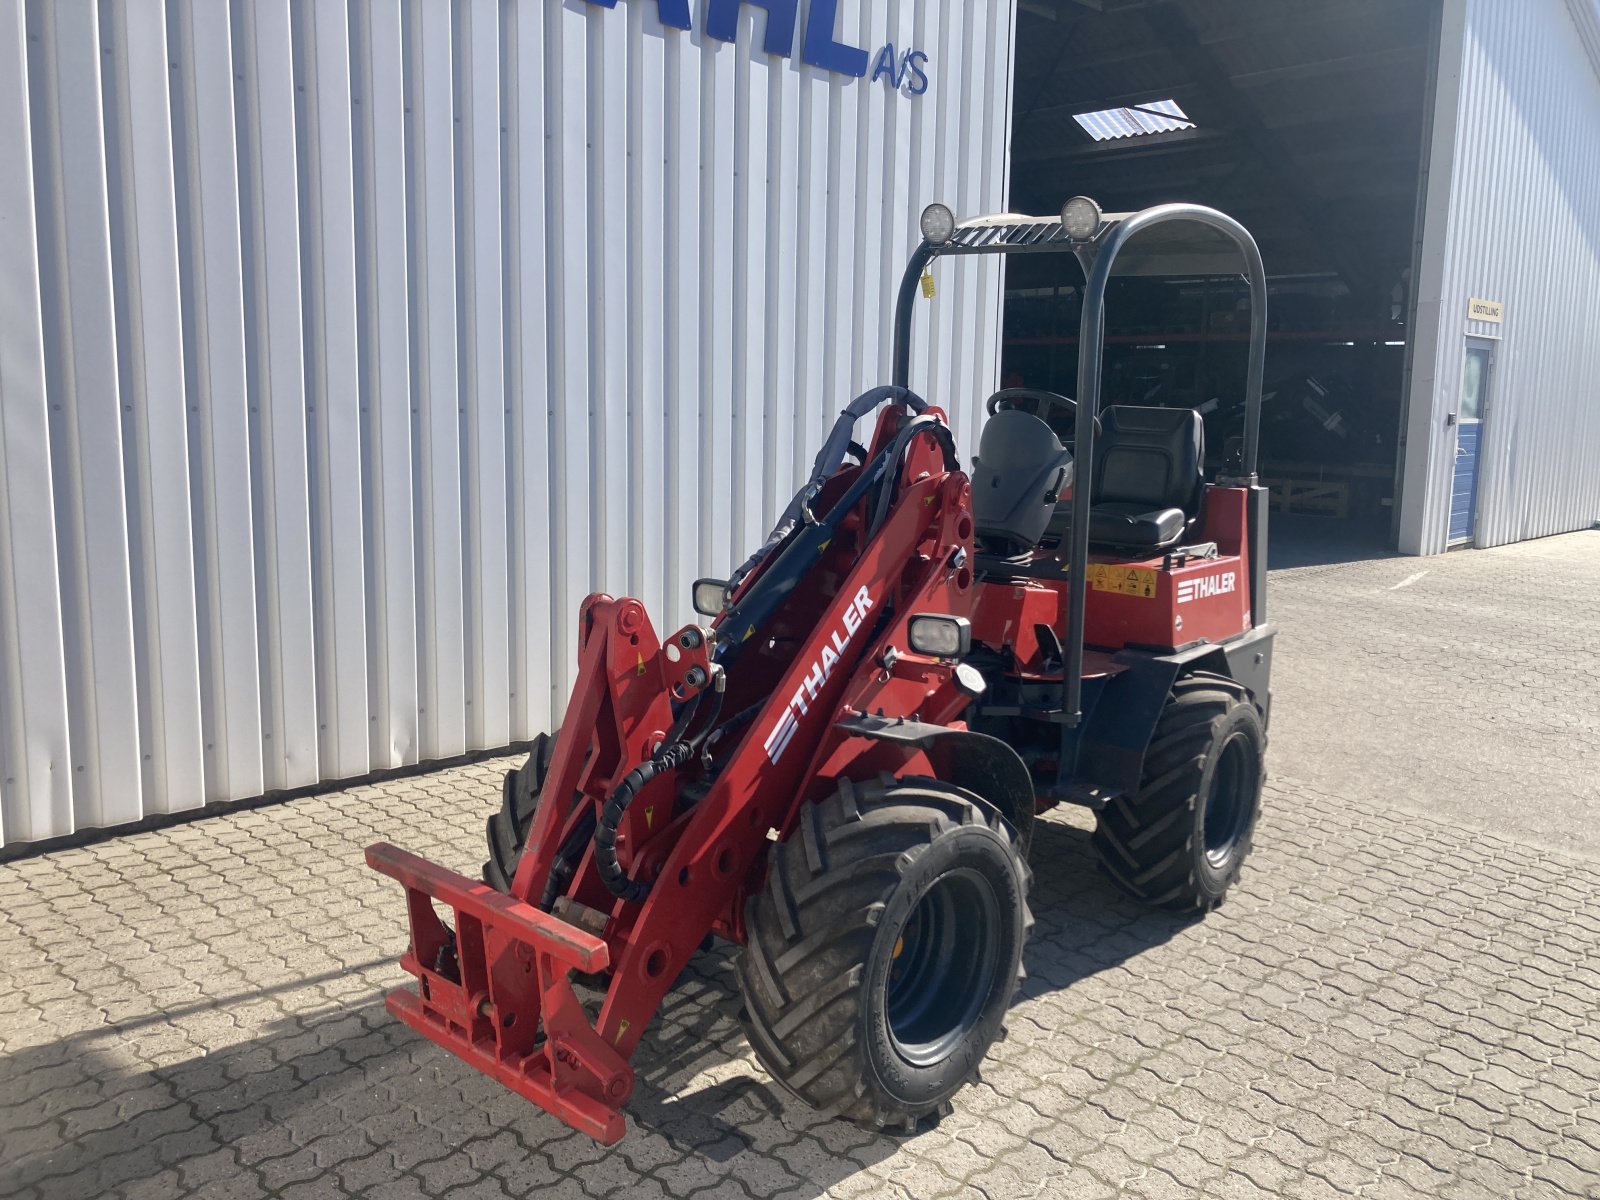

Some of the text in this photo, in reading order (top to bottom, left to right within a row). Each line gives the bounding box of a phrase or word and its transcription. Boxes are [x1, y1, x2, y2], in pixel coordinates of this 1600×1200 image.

[873, 43, 928, 95] A/S
[1473, 304, 1499, 317] UDSTILLING
[1192, 572, 1236, 600] THALER
[790, 585, 874, 717] THALER
